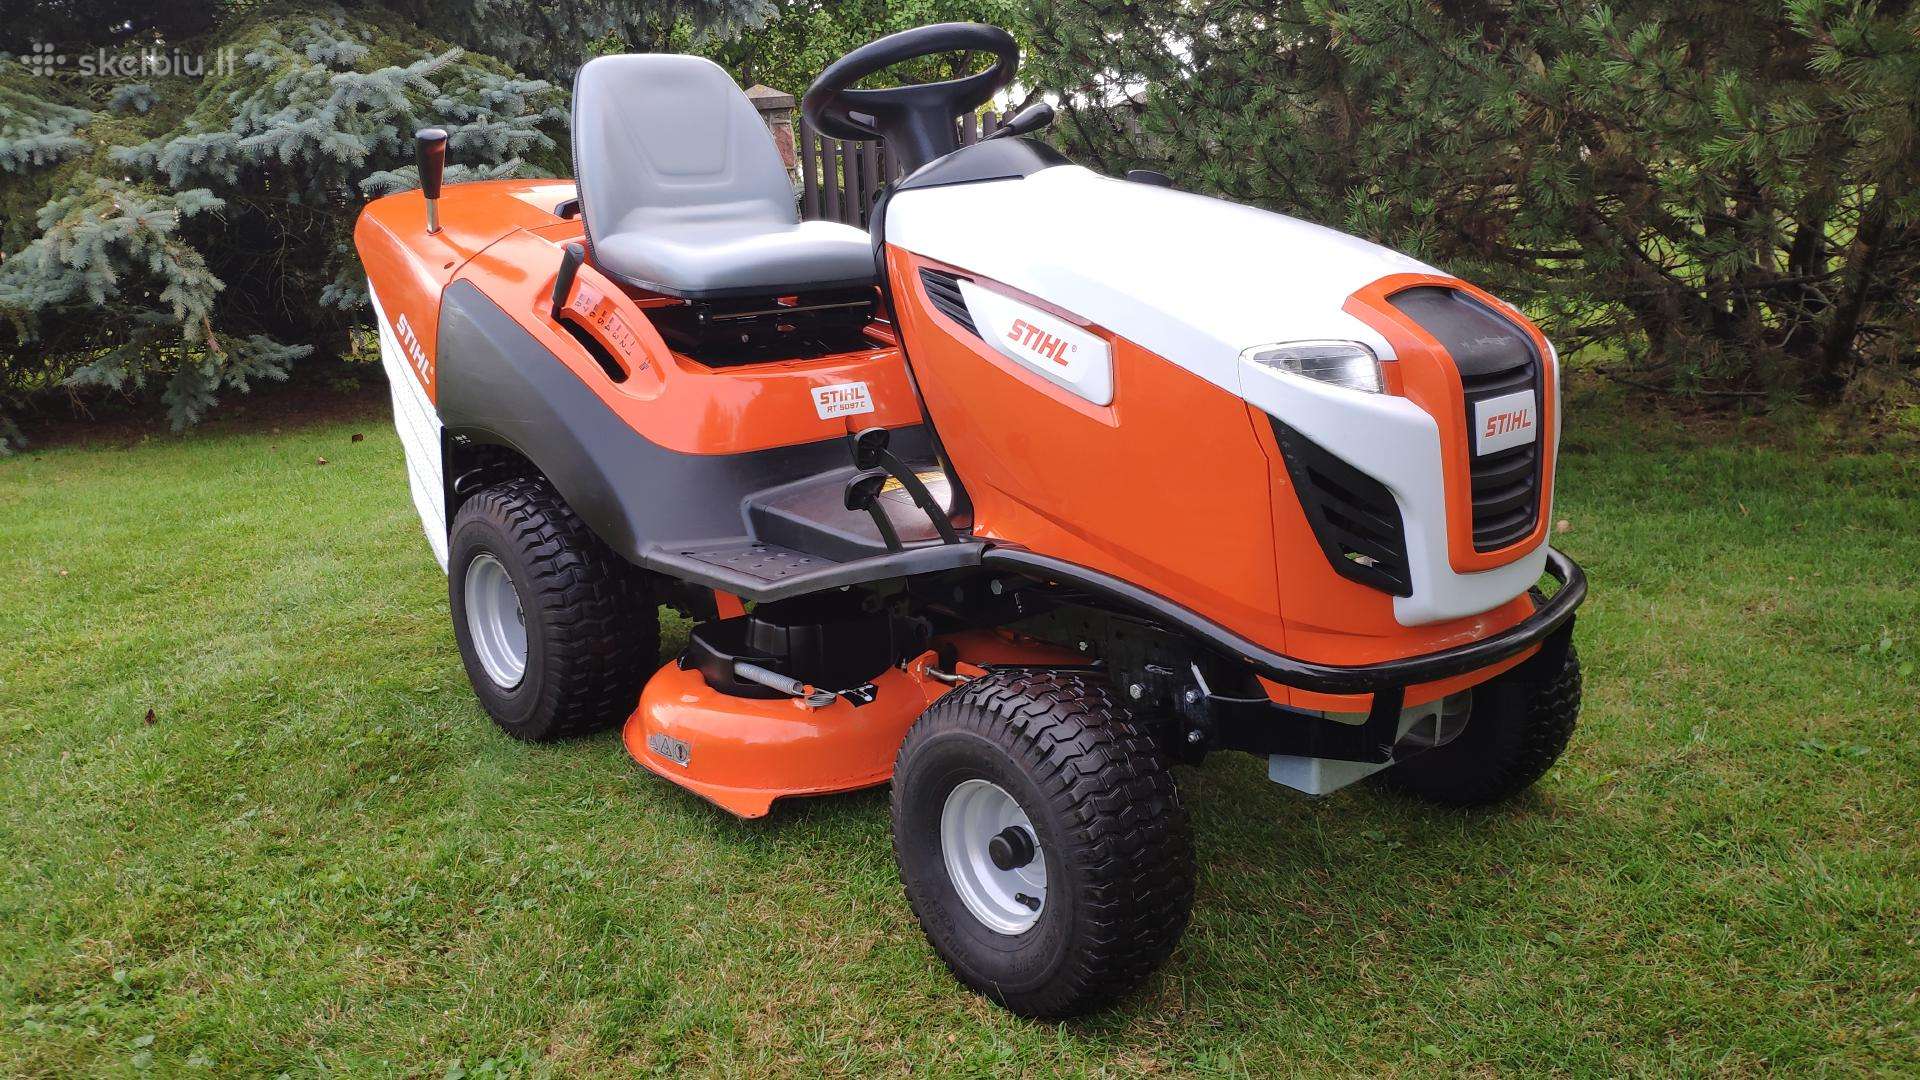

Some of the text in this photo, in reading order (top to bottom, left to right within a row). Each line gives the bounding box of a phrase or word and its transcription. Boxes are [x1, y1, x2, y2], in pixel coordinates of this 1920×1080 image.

[396, 312, 430, 385] STIHL
[820, 387, 865, 405] STIHL
[827, 404, 837, 413] RT
[840, 402, 859, 411] 5097
[1485, 408, 1532, 437] STIHL
